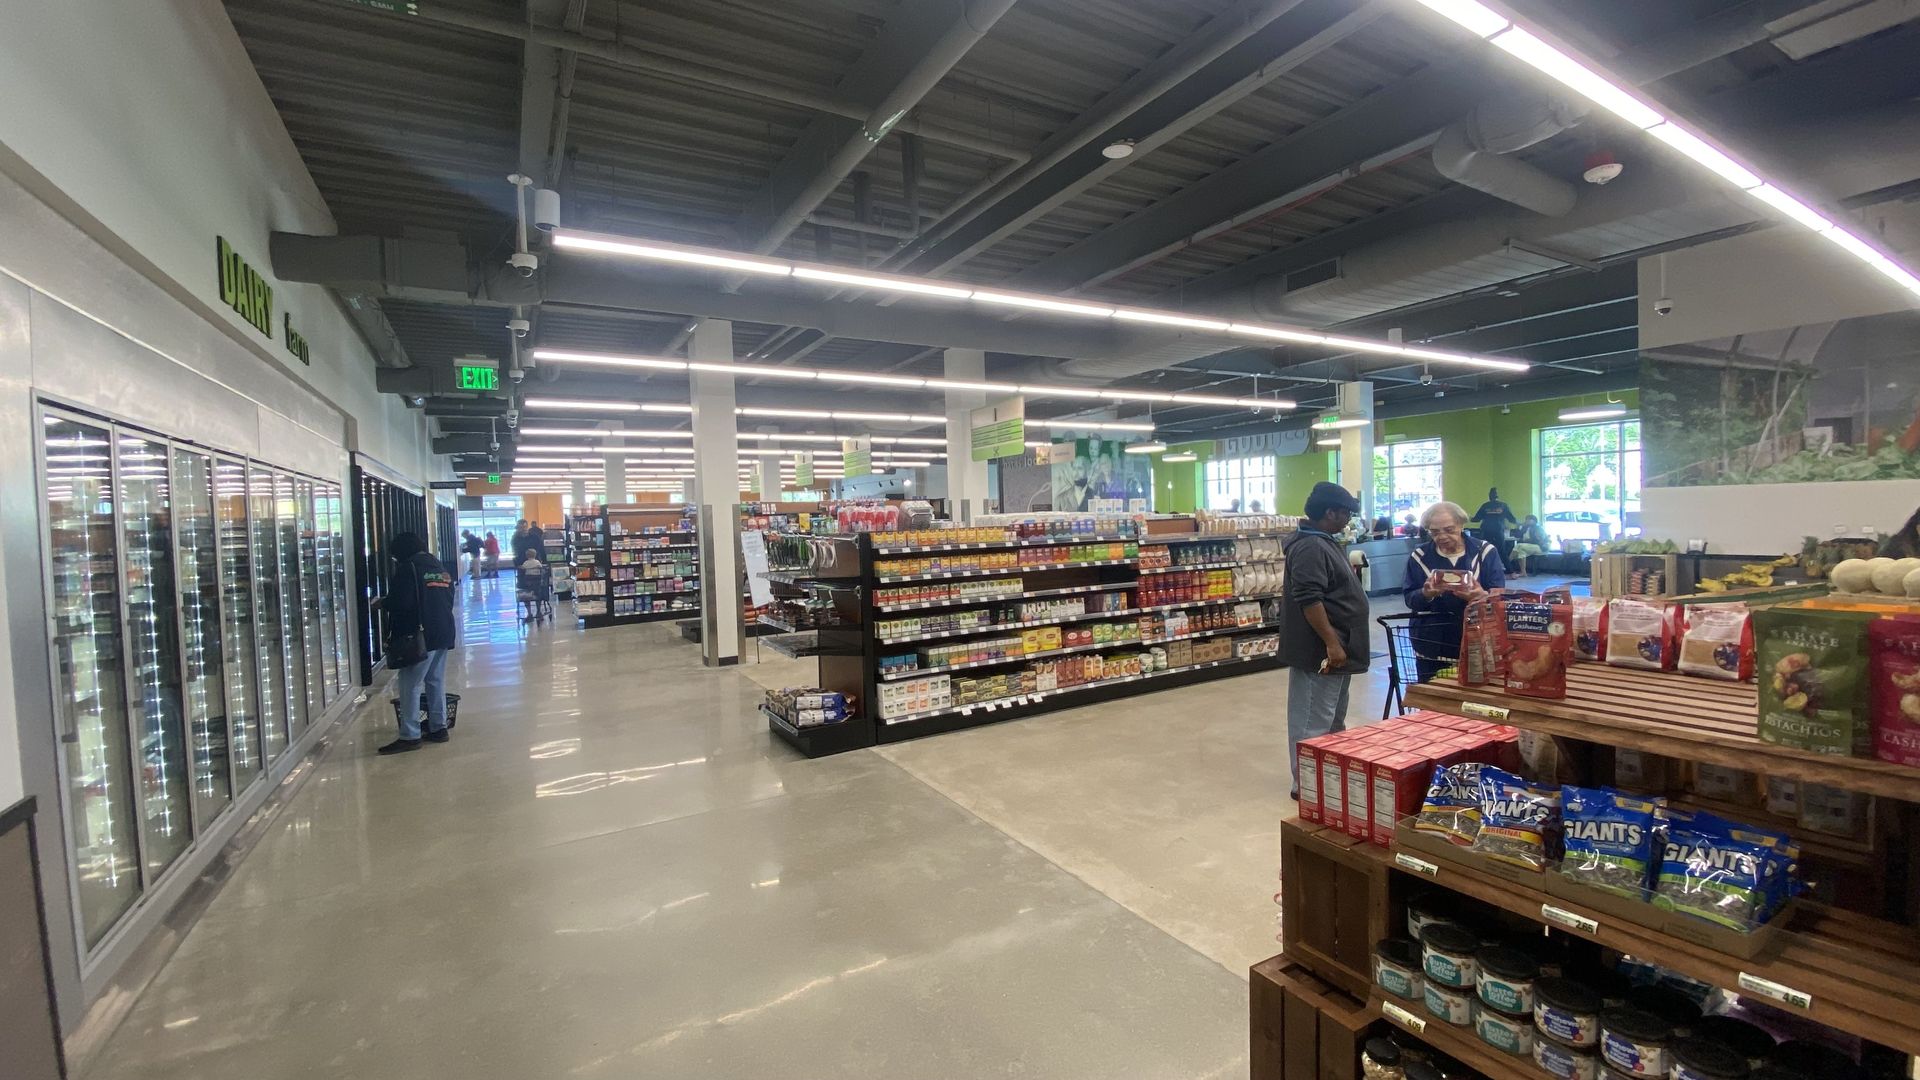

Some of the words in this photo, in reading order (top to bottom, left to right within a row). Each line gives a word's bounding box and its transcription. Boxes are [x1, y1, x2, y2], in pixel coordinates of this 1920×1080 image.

[217, 235, 273, 340] DAIRY
[284, 312, 310, 367] farm
[462, 366, 494, 390] EXIT
[1508, 614, 1548, 625] PLANTERS
[1771, 629, 1840, 648] SAHALE
[1488, 709, 1504, 719] 5.39
[1485, 827, 1521, 838] ORIGINAL
[1563, 820, 1641, 846] GIANTS
[1663, 842, 1758, 875] GIANTS
[1575, 920, 1593, 934] 2.65
[1486, 982, 1517, 998] Butter
[1782, 992, 1806, 1009] 4.65
[1407, 1018, 1421, 1032] 4.09
